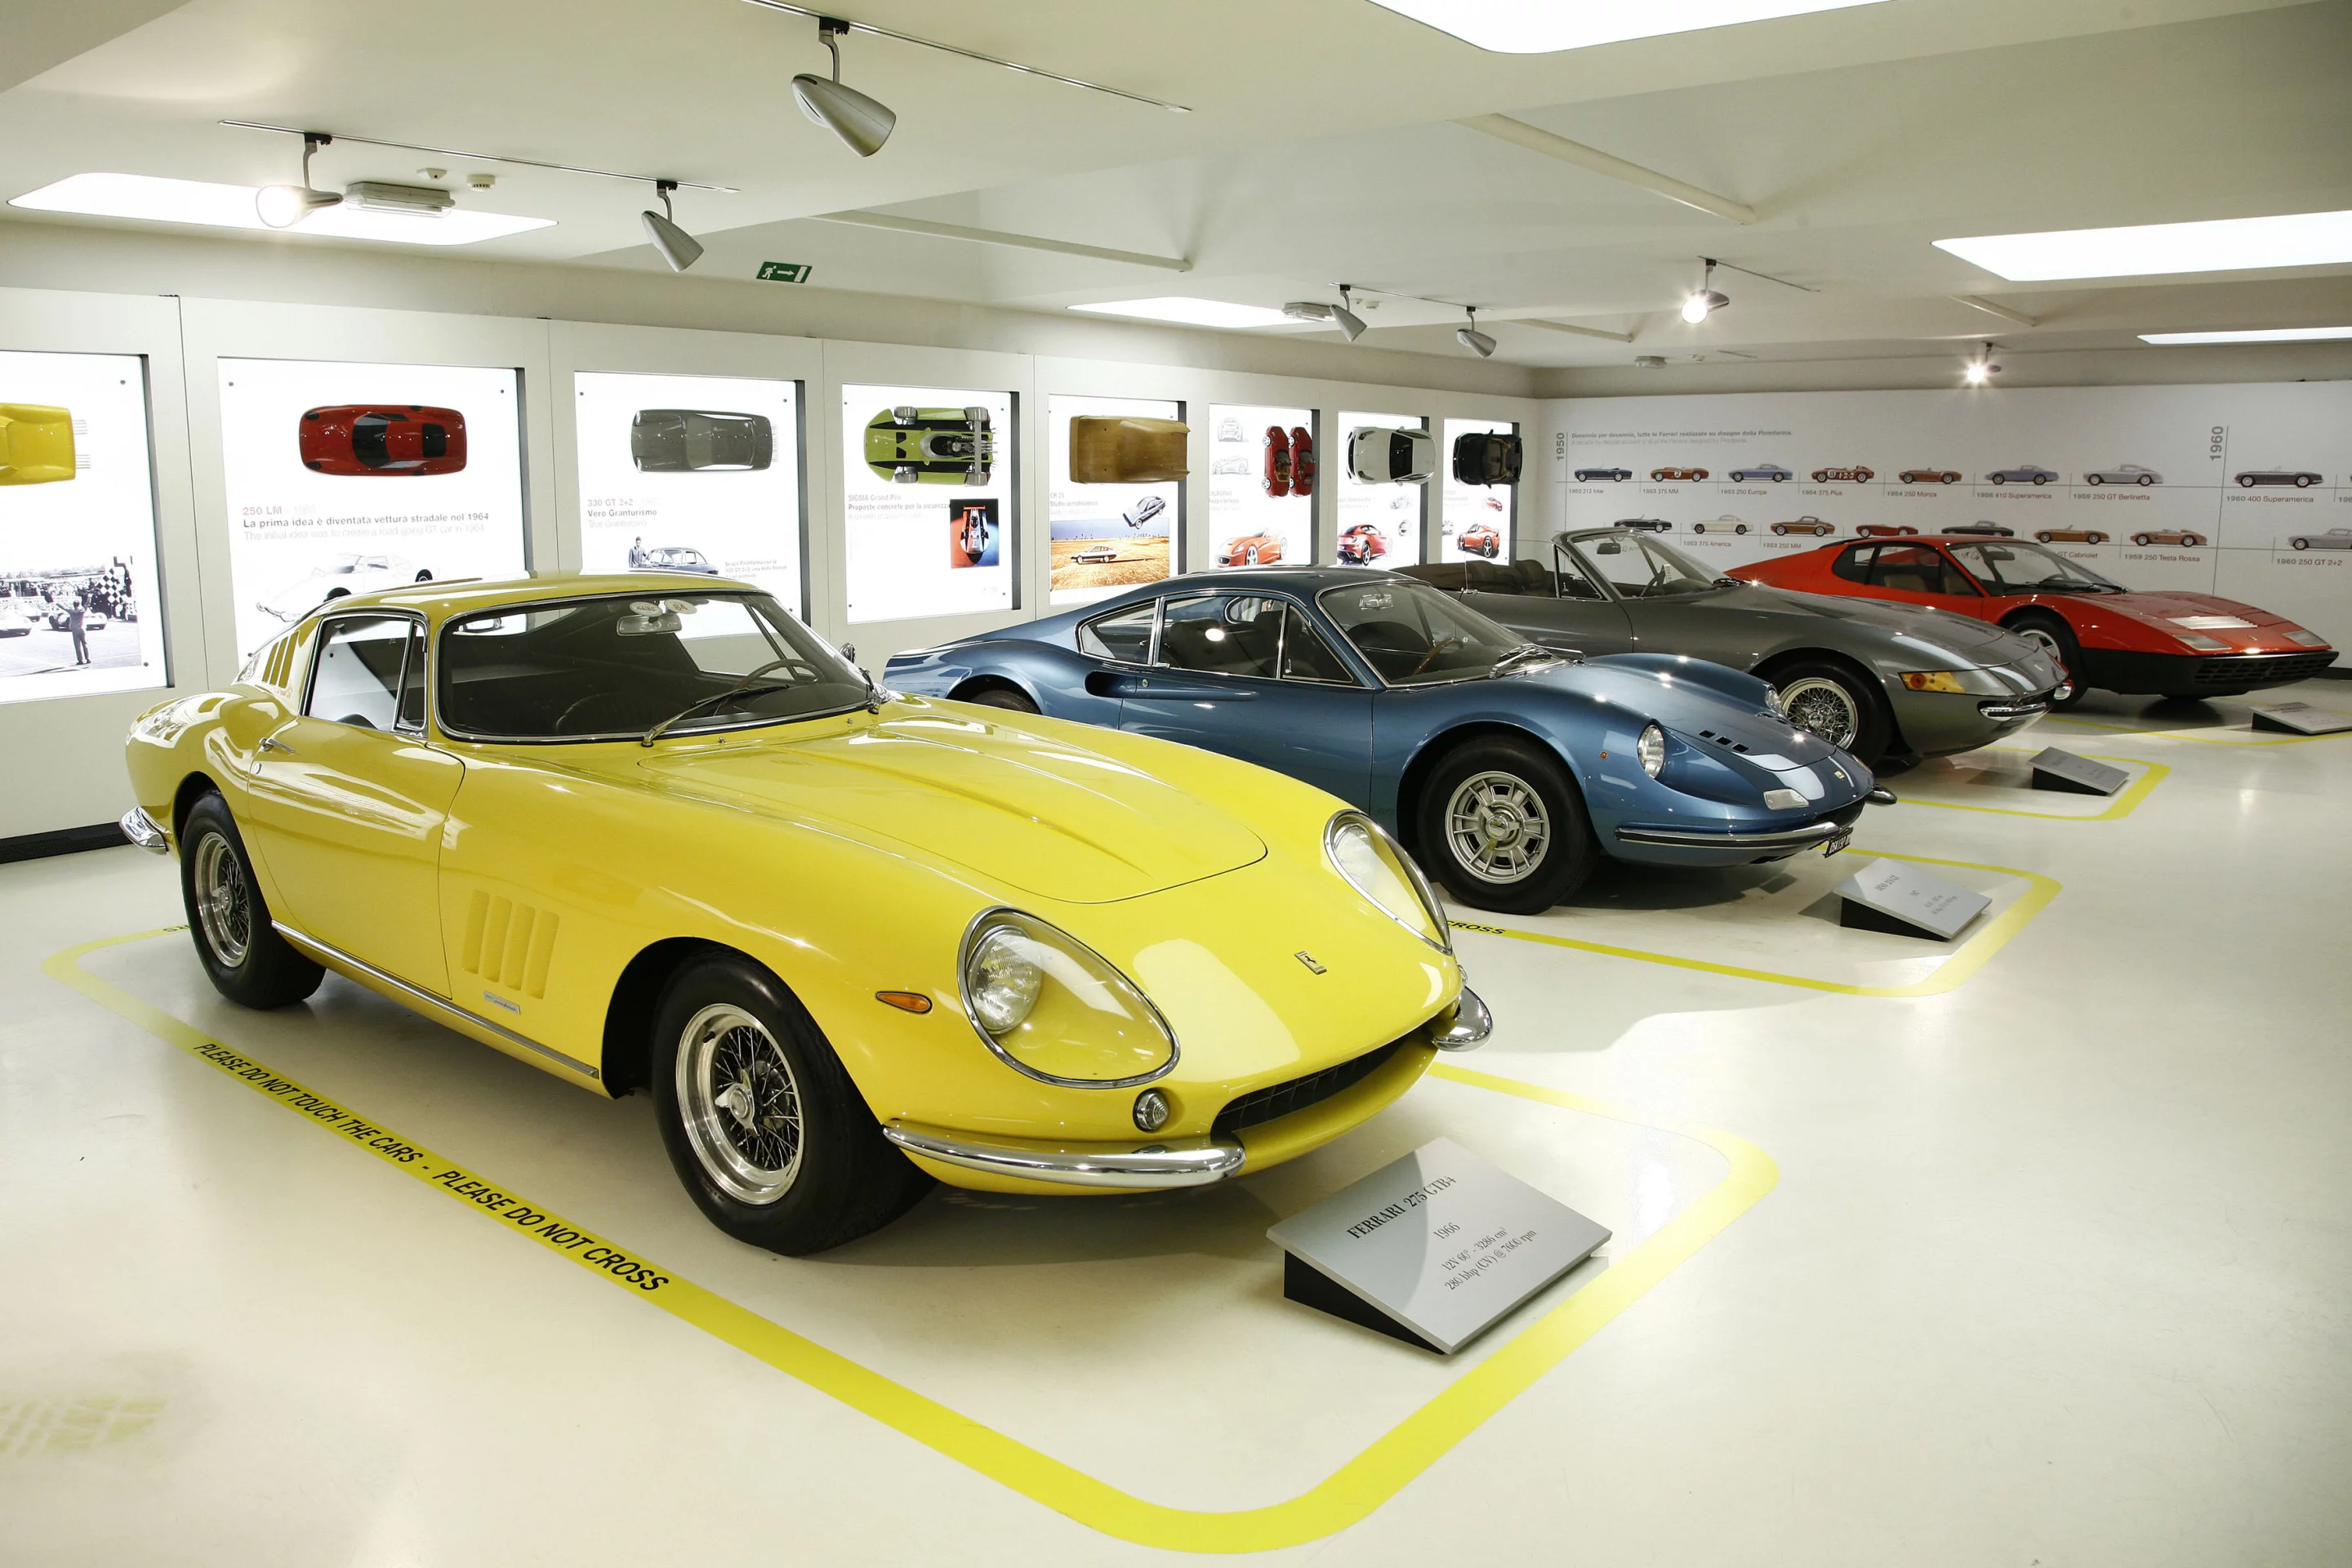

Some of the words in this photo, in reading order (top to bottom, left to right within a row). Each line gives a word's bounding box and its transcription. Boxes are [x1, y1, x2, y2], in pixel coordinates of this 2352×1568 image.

[1556, 432, 1565, 461] 1950
[2209, 425, 2224, 461] 1960
[243, 506, 262, 515] 250
[266, 506, 282, 515] LM
[587, 499, 603, 507] 330
[605, 498, 616, 506] GT
[619, 498, 634, 506] 2+2
[849, 503, 875, 511] Proposte
[243, 519, 256, 528] La
[259, 519, 288, 529] prima
[292, 518, 314, 526] idea
[317, 518, 323, 526] è
[326, 516, 371, 525] diventata
[374, 516, 408, 524] vettura
[411, 514, 448, 523] stradale
[468, 513, 489, 521] 1964
[588, 510, 606, 518] Vero
[608, 509, 657, 517] Granturismo
[588, 519, 603, 528] True
[245, 531, 261, 541] The
[425, 525, 437, 533] GT
[1446, 920, 1506, 934] CROSS
[194, 1044, 252, 1071] PLEASE
[238, 1067, 270, 1080] DO
[257, 1078, 301, 1095] NOT
[287, 1093, 349, 1123] TOUCH
[336, 1119, 381, 1140] THE
[369, 1137, 424, 1163] CARS
[432, 1170, 517, 1210] PLEASE
[502, 1206, 546, 1226] DO
[534, 1223, 595, 1250] NOT
[582, 1248, 670, 1291] CROSS
[1346, 1203, 1406, 1239] FERRARI
[1403, 1192, 1428, 1208] 275
[1423, 1175, 1457, 1196] GTB4
[1433, 1222, 1460, 1240] 1966
[1441, 1257, 1460, 1271] 12V
[1474, 1235, 1496, 1251] 3286
[1444, 1276, 1463, 1290] 280
[1458, 1268, 1481, 1281] bhp
[1475, 1254, 1499, 1271] (CV)
[1493, 1249, 1507, 1258] @
[1500, 1237, 1522, 1252] 7600
[1520, 1230, 1537, 1242] rpm
